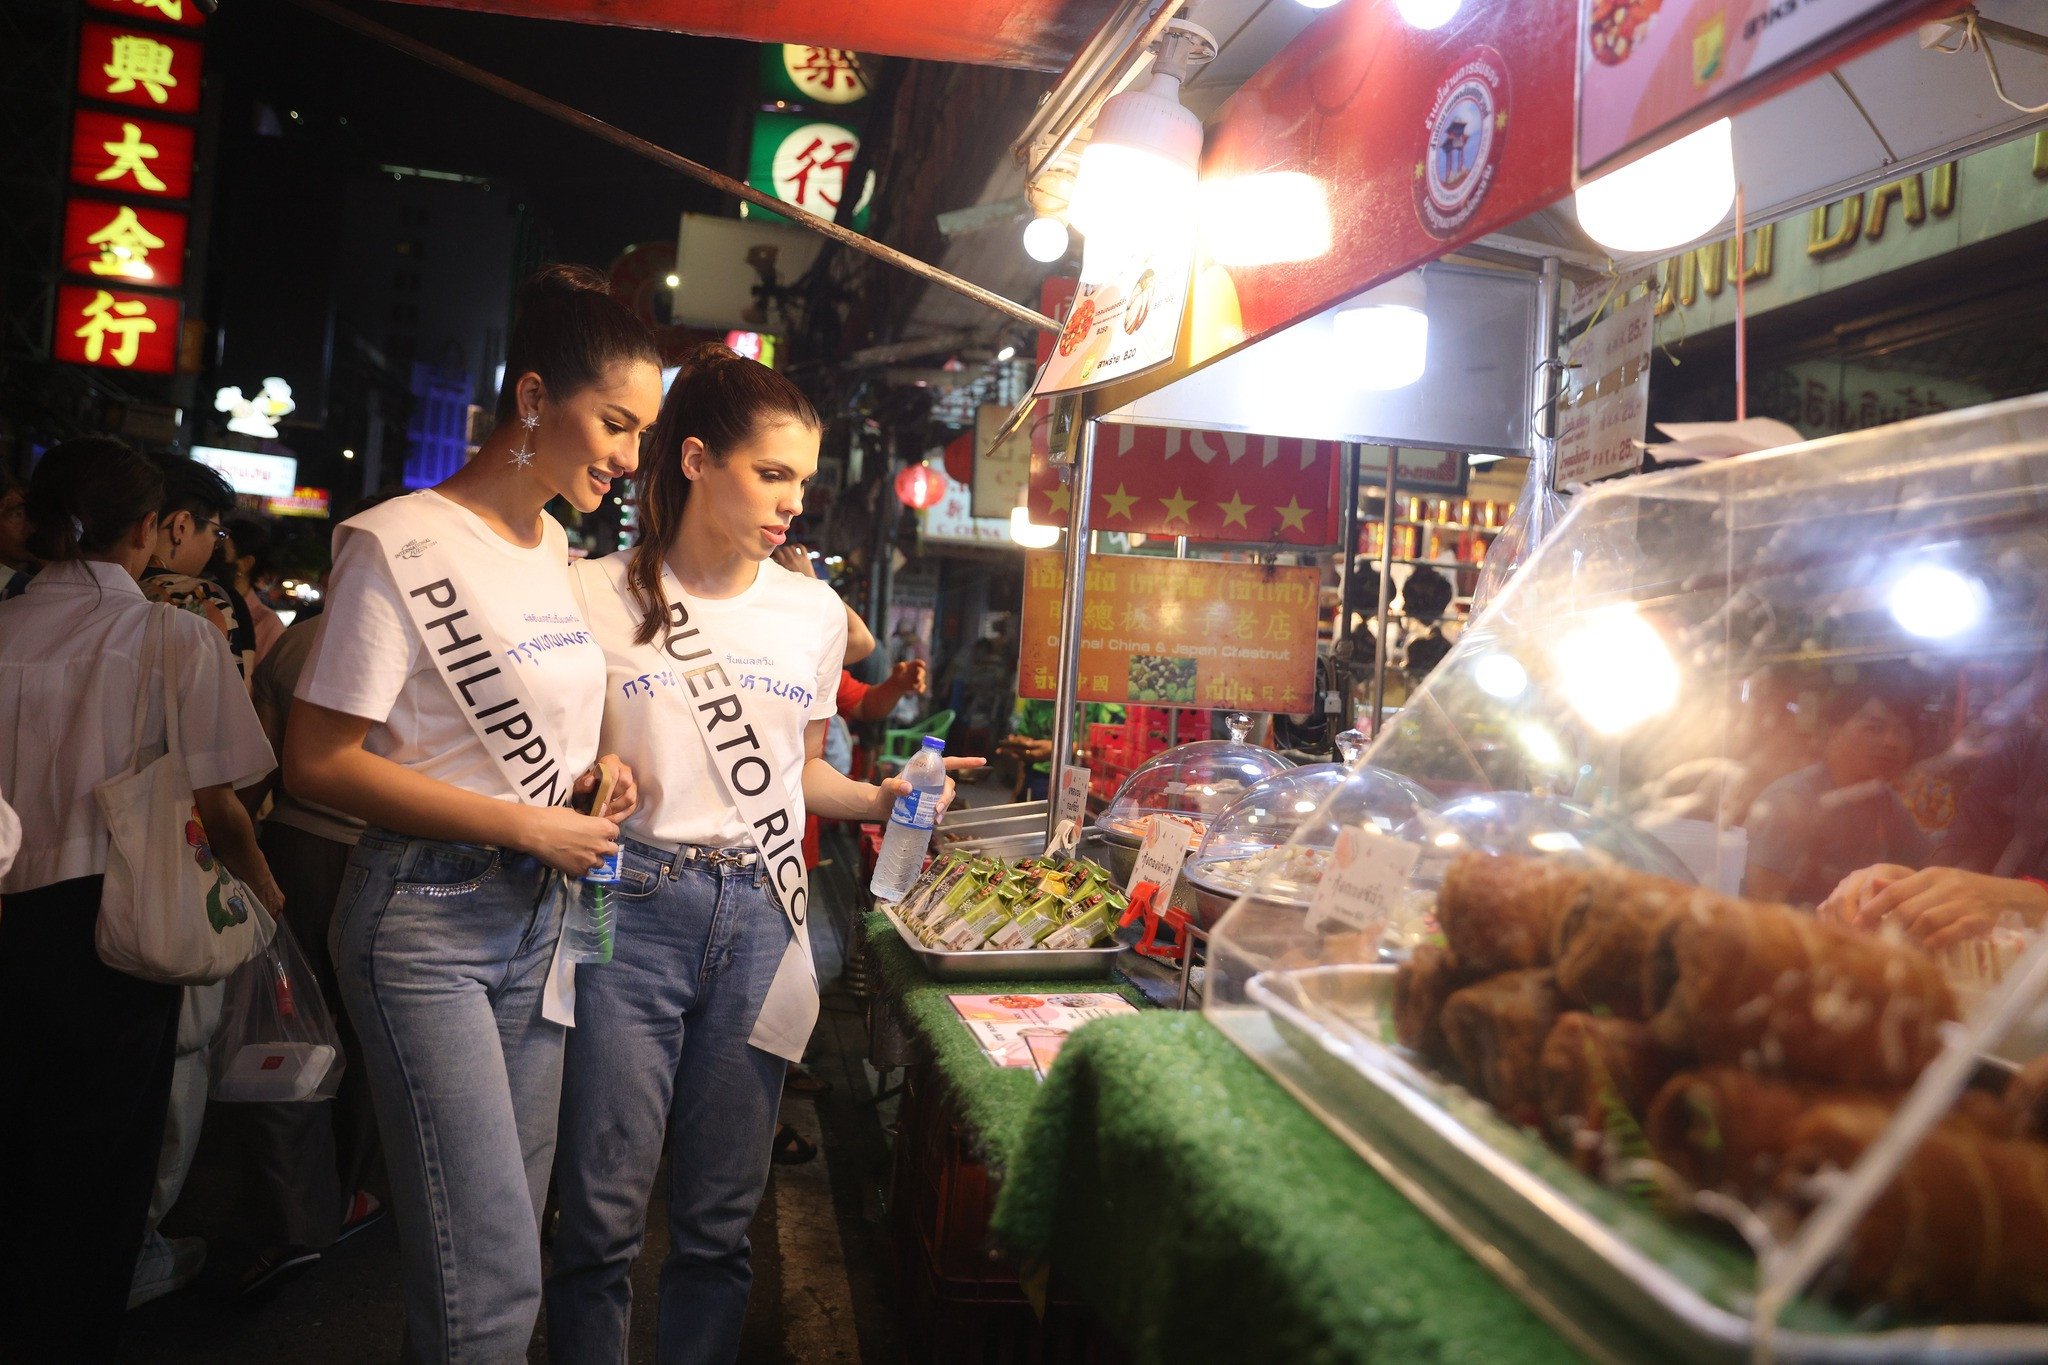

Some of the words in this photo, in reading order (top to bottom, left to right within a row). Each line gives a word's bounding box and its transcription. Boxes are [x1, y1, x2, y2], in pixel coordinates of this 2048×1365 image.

[1108, 639, 1151, 652] China
[1155, 642, 1166, 653] &
[1171, 643, 1217, 657] Japan
[1221, 646, 1291, 660] Chestnut
[664, 601, 771, 797] PUERTO
[753, 808, 807, 926] RICO
